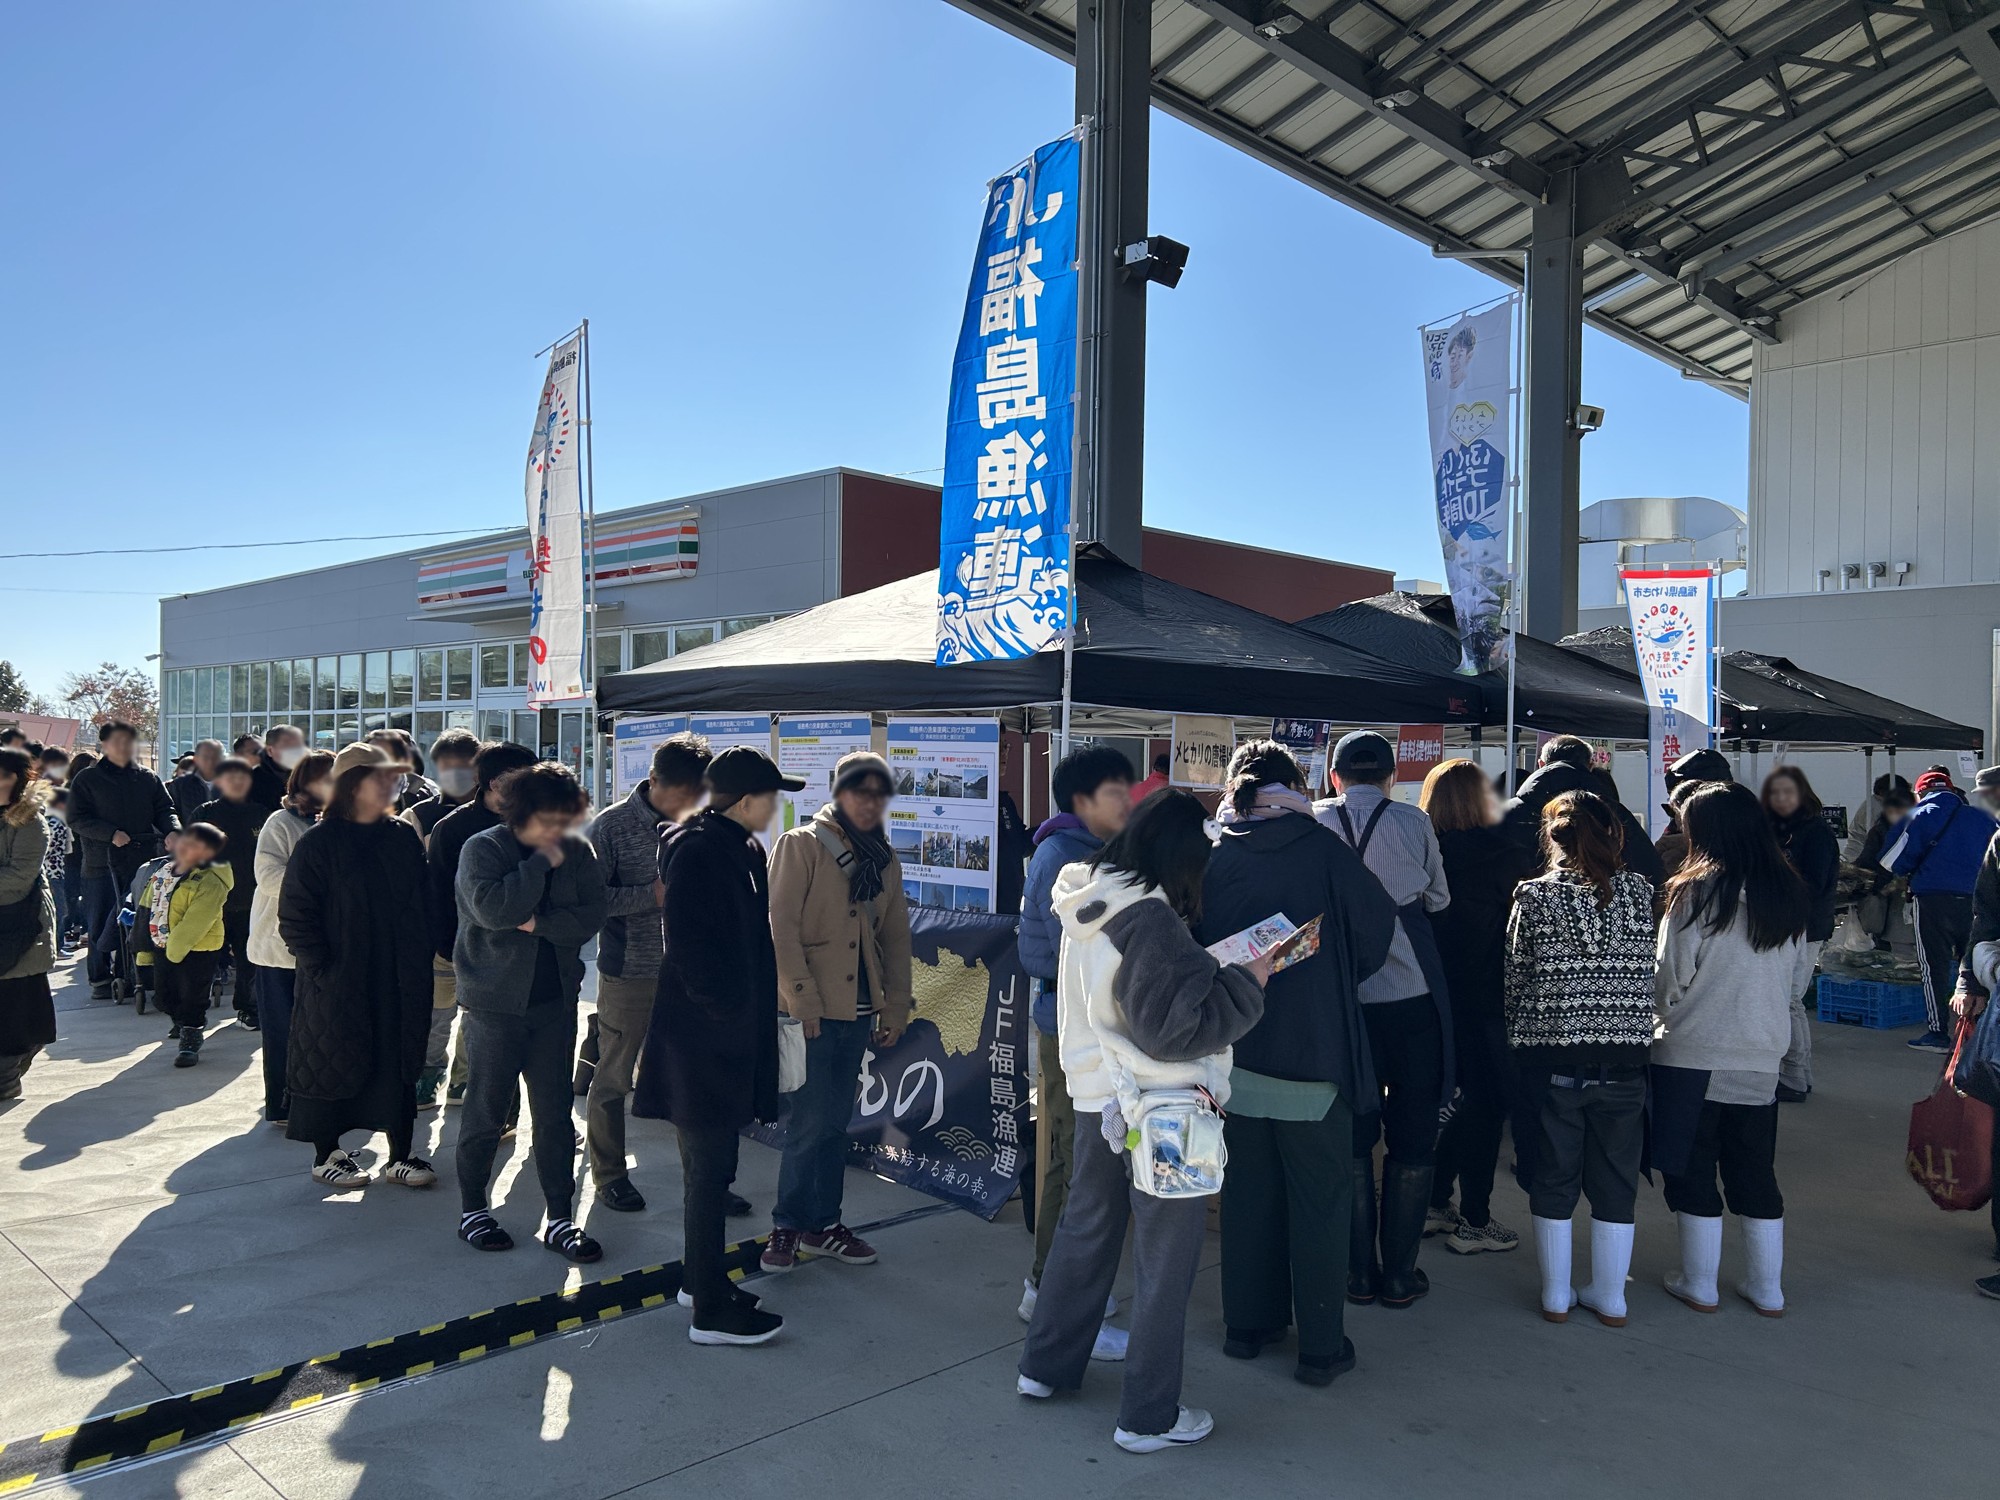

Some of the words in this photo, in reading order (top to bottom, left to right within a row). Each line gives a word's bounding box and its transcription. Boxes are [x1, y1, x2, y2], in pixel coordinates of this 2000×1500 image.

[1398, 740, 1442, 763] 無料提供中
[856, 1047, 945, 1132] もの
[987, 974, 1018, 1179] JF福島漁連
[848, 1140, 989, 1200] みが集結する海の幸。
